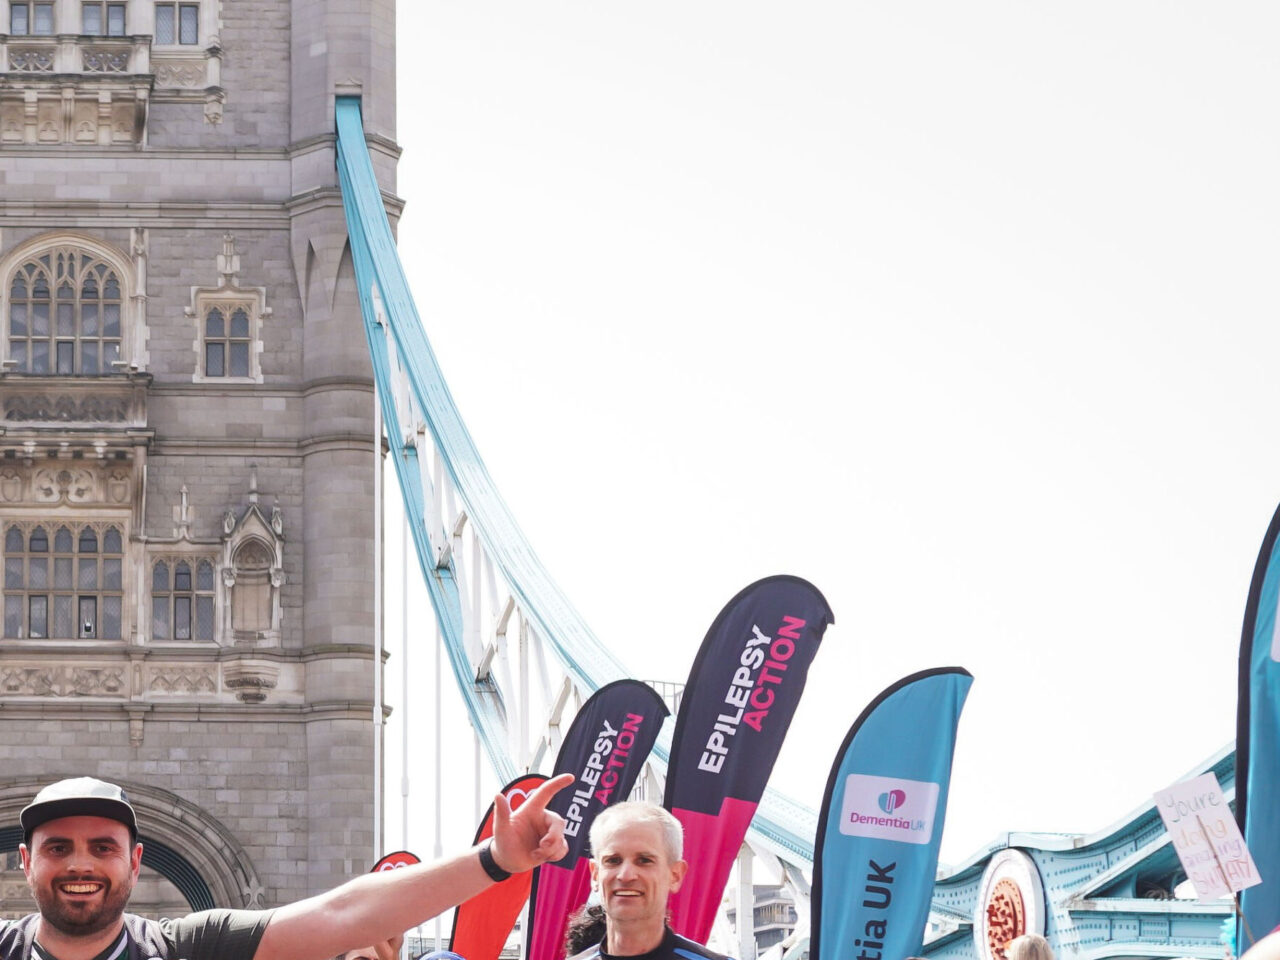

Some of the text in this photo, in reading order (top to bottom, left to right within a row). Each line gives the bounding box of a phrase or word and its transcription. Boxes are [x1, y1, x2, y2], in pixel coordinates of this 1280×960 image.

[697, 624, 772, 775] EPILEPSY
[744, 615, 807, 733] ACTION
[565, 720, 618, 838] EPILEPSY
[593, 712, 644, 807] ACTION
[863, 860, 897, 910] UK
